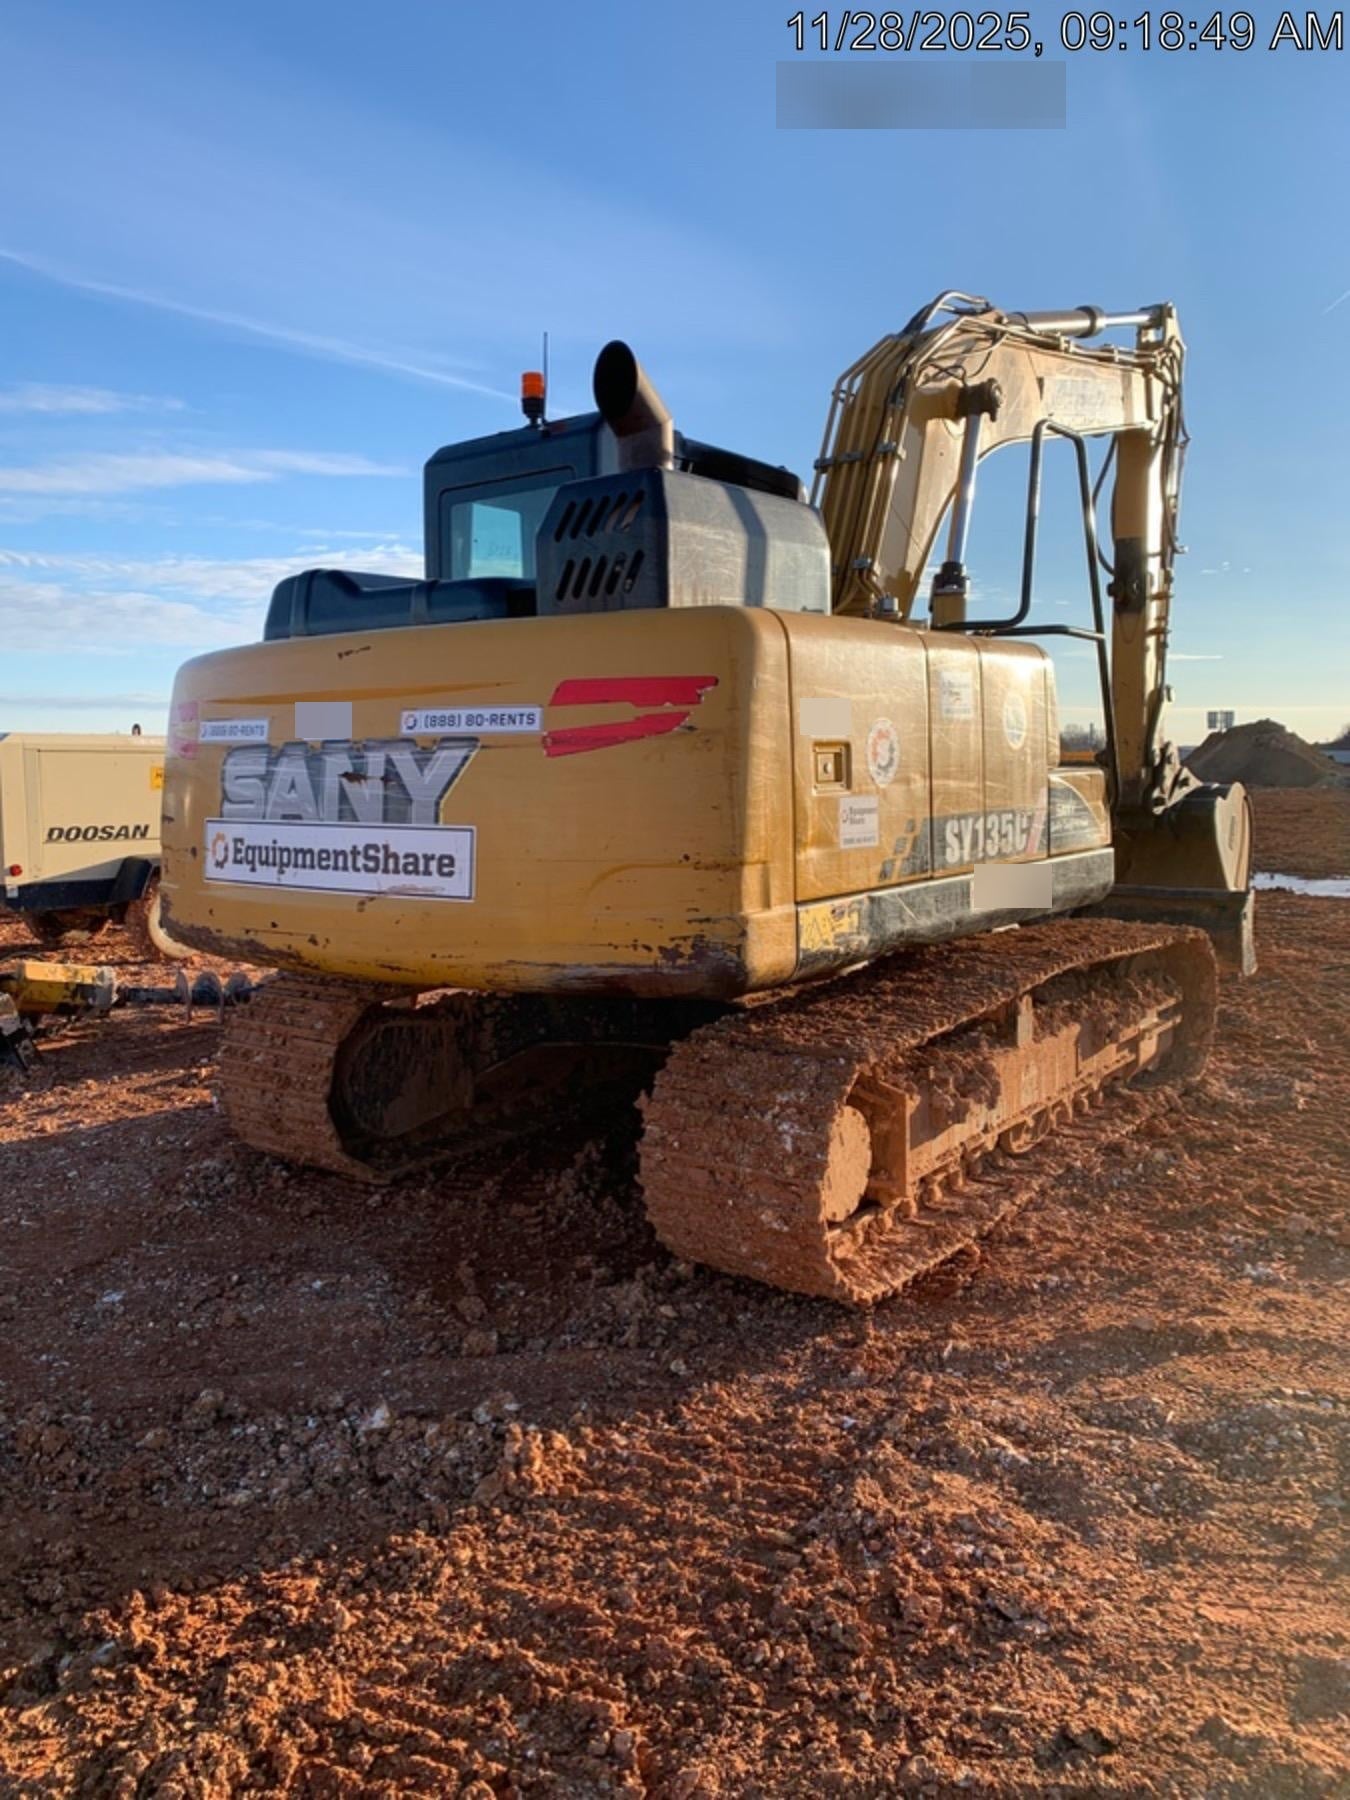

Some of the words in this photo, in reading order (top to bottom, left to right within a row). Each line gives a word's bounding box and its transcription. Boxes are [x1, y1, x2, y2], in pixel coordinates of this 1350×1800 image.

[424, 714, 461, 729] (888)
[465, 712, 536, 727] 80-RENTS
[221, 737, 479, 823] SANY
[46, 824, 149, 842] DOOSAN
[231, 838, 456, 878] EquipmentShare
